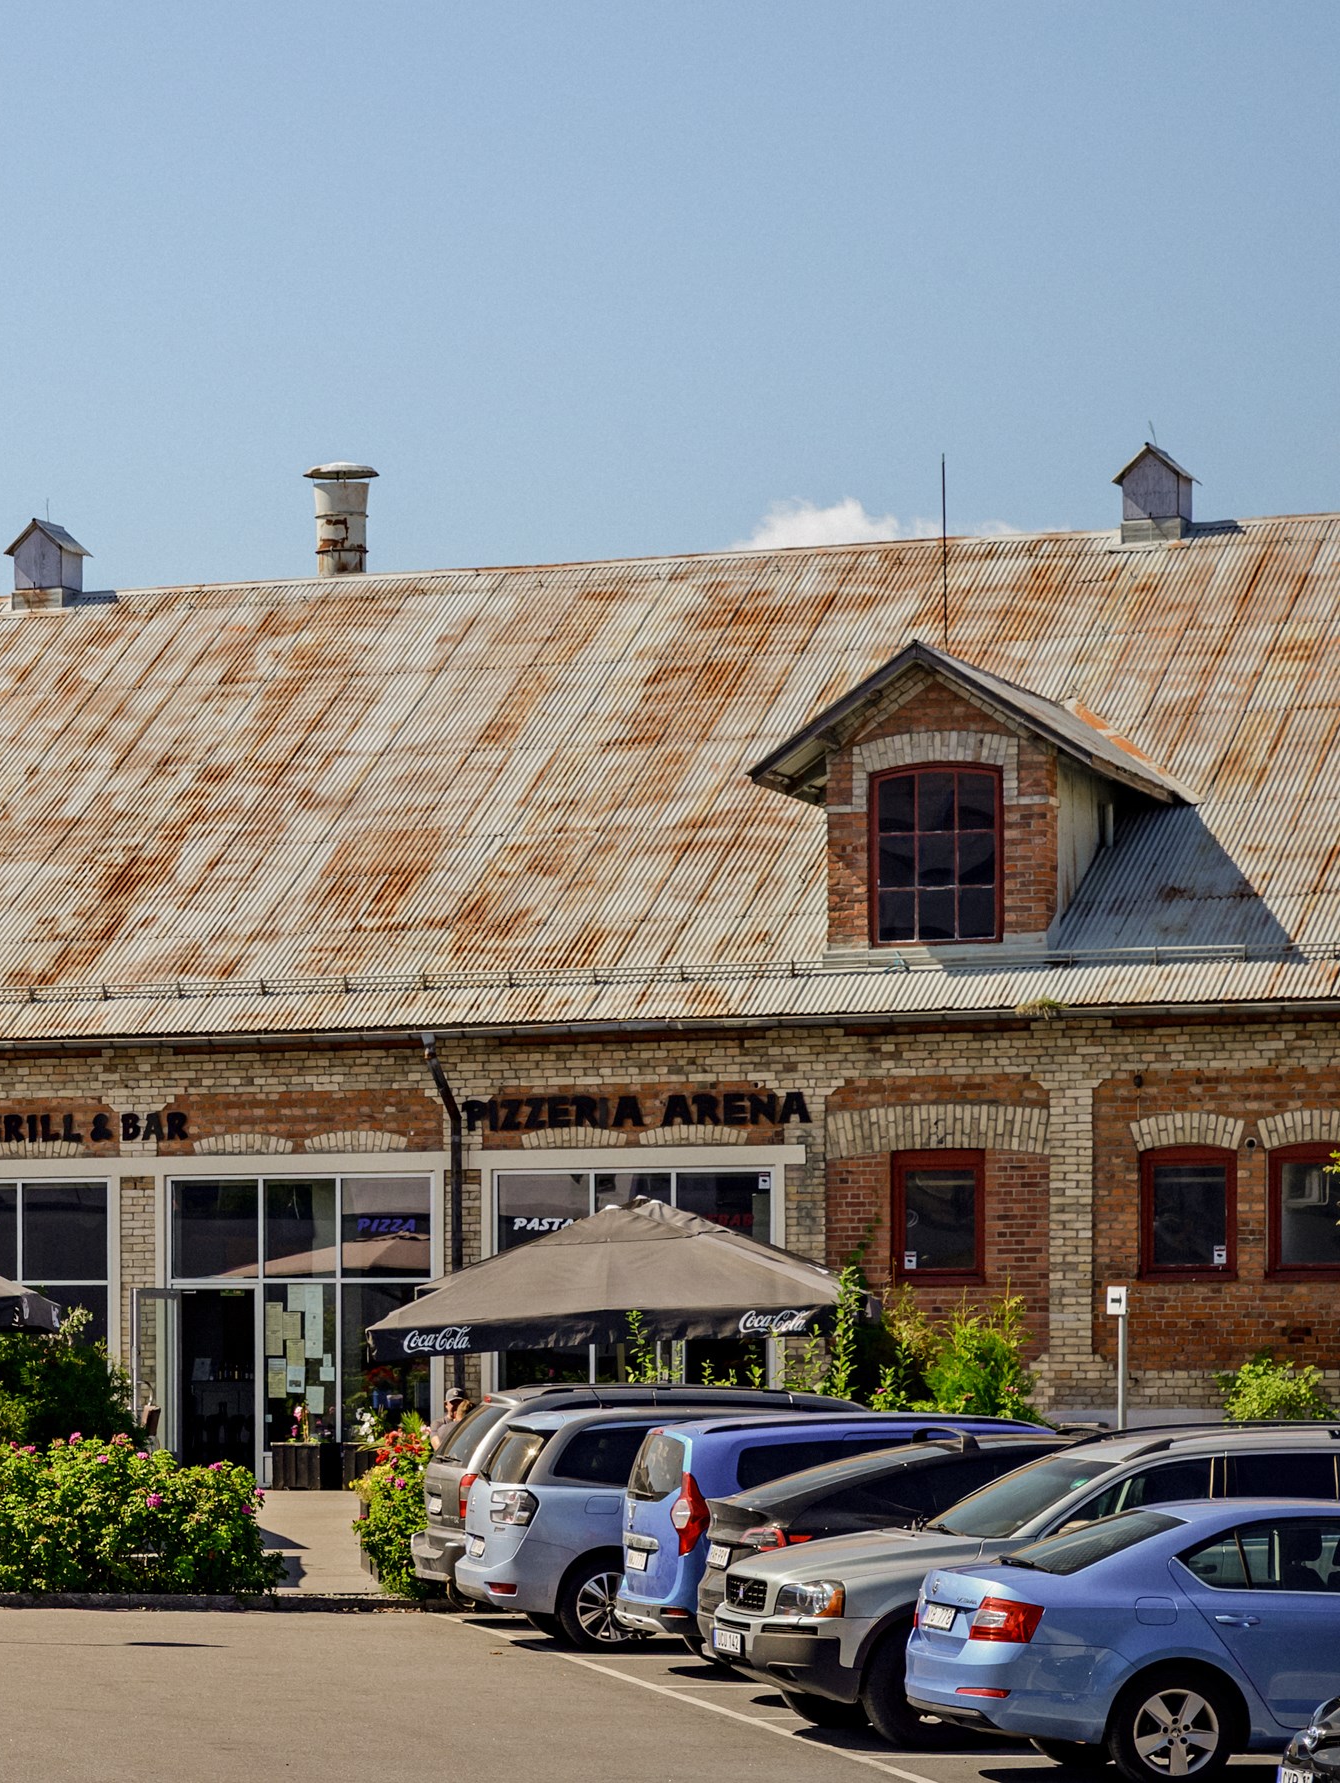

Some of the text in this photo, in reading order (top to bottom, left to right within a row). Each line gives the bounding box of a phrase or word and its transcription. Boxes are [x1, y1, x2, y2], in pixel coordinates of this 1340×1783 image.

[462, 1091, 812, 1132] PIZZERIA ARENA
[90, 1112, 114, 1142] &
[121, 1111, 189, 1142] BAR
[357, 1217, 416, 1232] PIZZA
[705, 1213, 754, 1227] EBAB
[738, 1309, 811, 1333] Coca-Cola
[403, 1326, 472, 1353] Coca-Cola
[728, 1633, 739, 1650] 142
